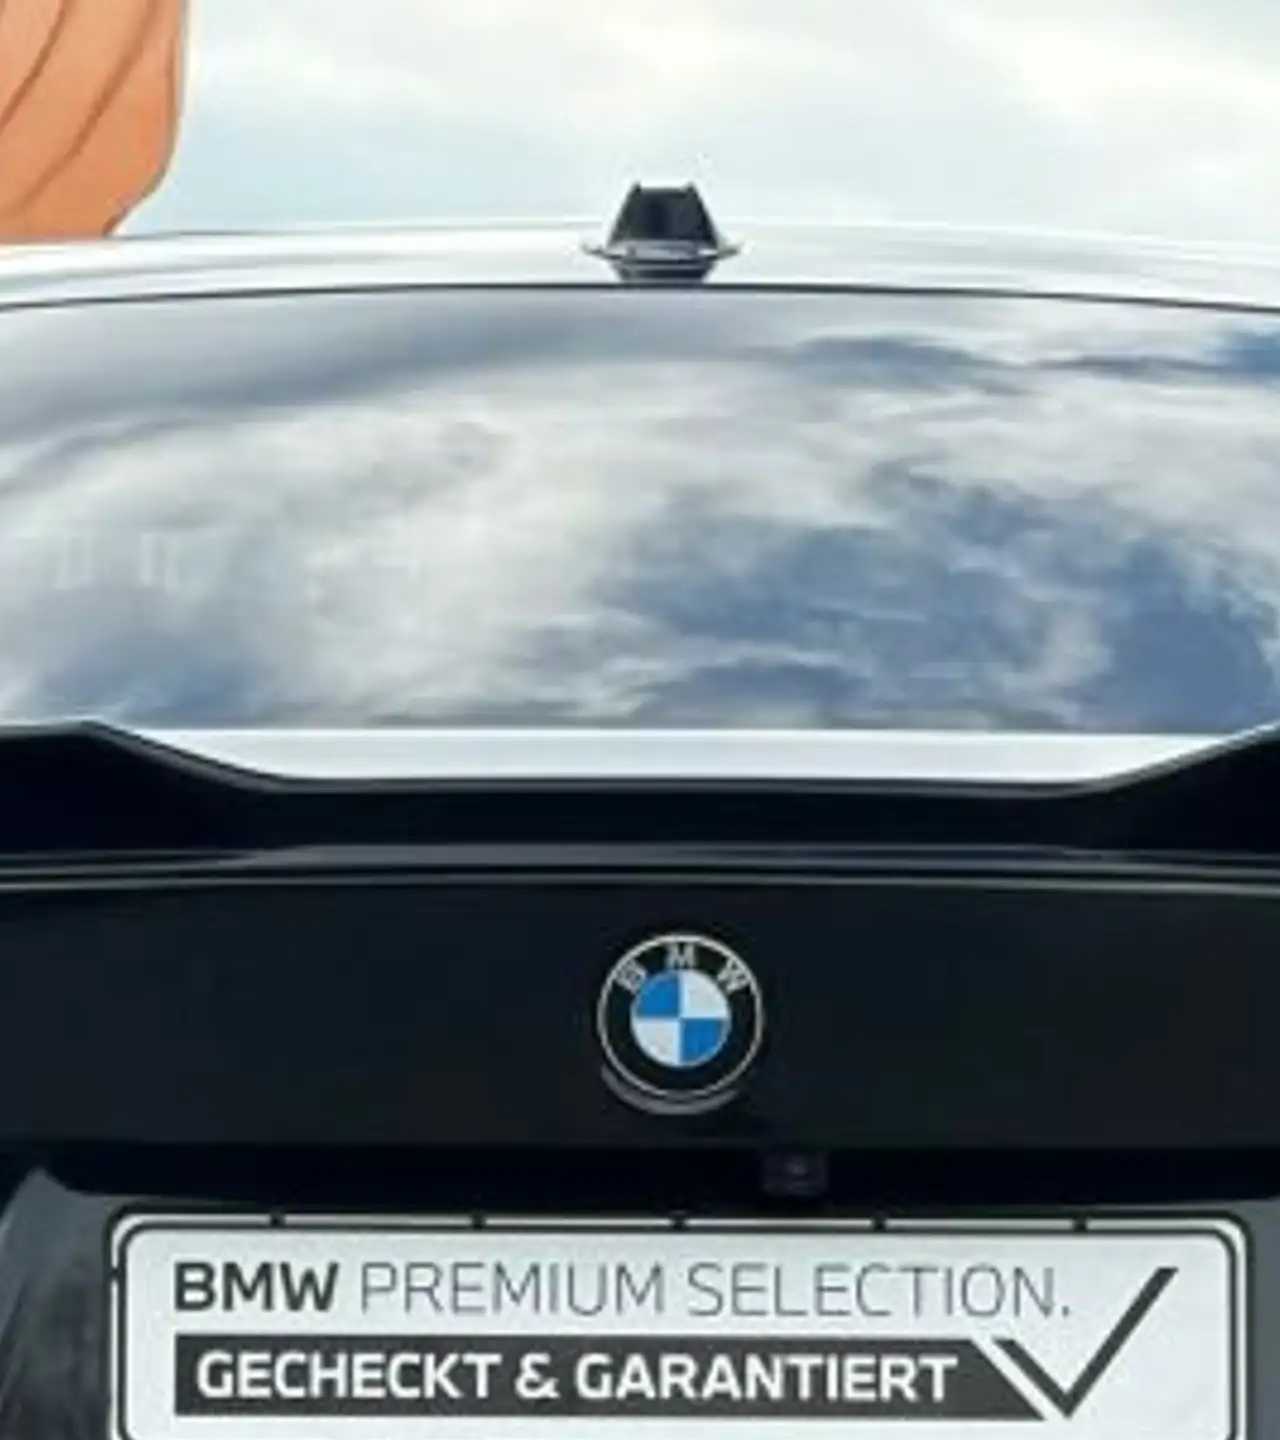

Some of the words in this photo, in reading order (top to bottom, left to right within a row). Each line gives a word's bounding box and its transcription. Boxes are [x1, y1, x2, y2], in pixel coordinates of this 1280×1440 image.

[614, 941, 751, 995] BMW
[172, 1262, 339, 1313] BMW
[360, 1263, 665, 1315] PREMIUM
[686, 1263, 1072, 1318] SELECTION.
[195, 1351, 500, 1401] GECHECKT
[515, 1352, 560, 1401] &
[574, 1352, 958, 1402] GARANTIERT
